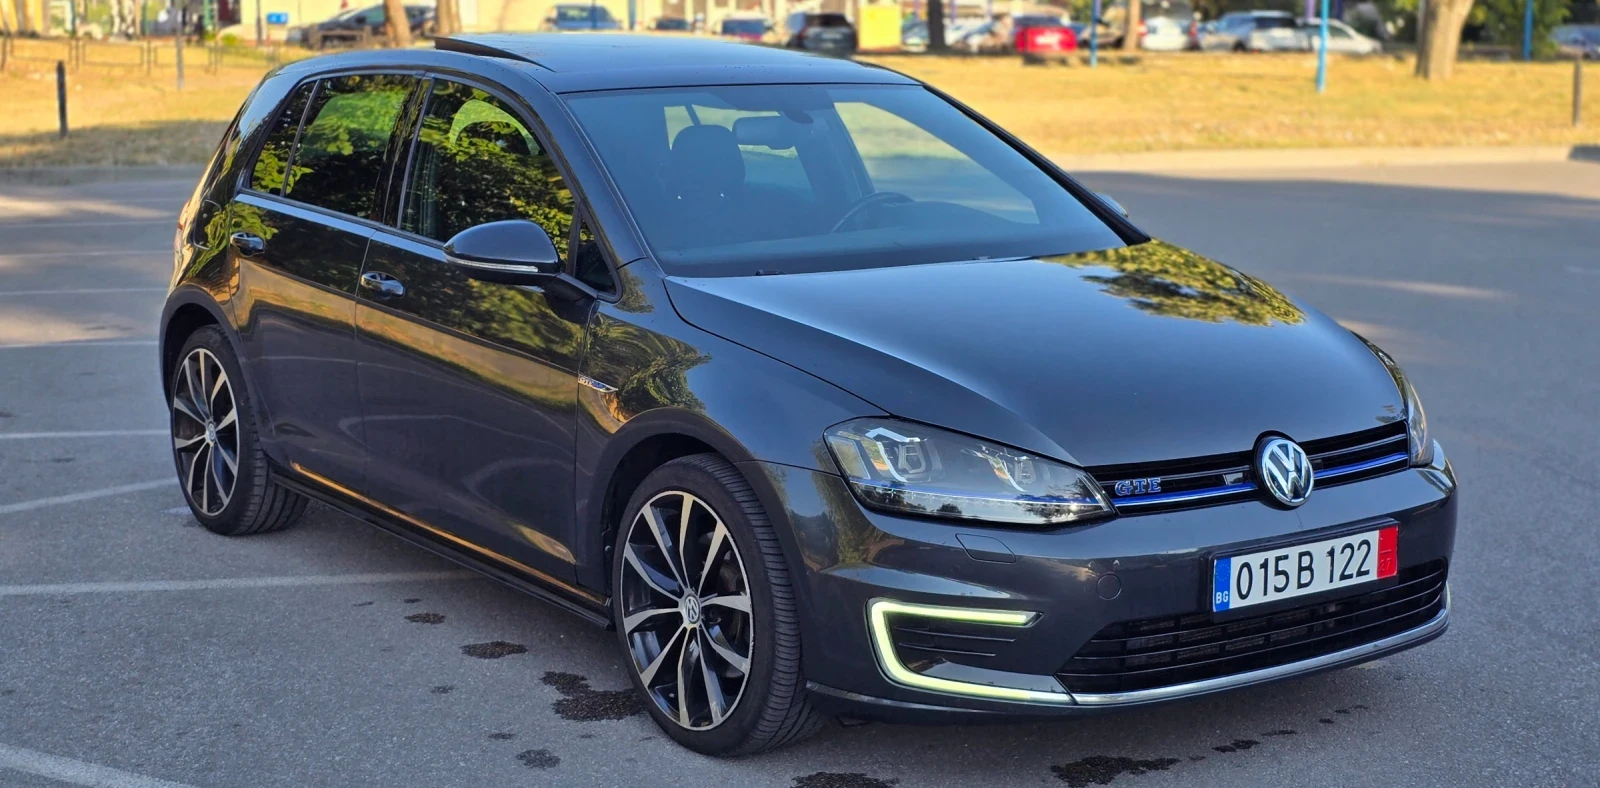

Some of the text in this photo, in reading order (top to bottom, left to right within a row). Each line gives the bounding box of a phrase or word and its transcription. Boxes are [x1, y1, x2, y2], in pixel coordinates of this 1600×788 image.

[1114, 477, 1162, 497] GTE
[1262, 438, 1313, 505] VW
[1236, 539, 1372, 600] 015 B 122
[1215, 590, 1229, 604] BG
